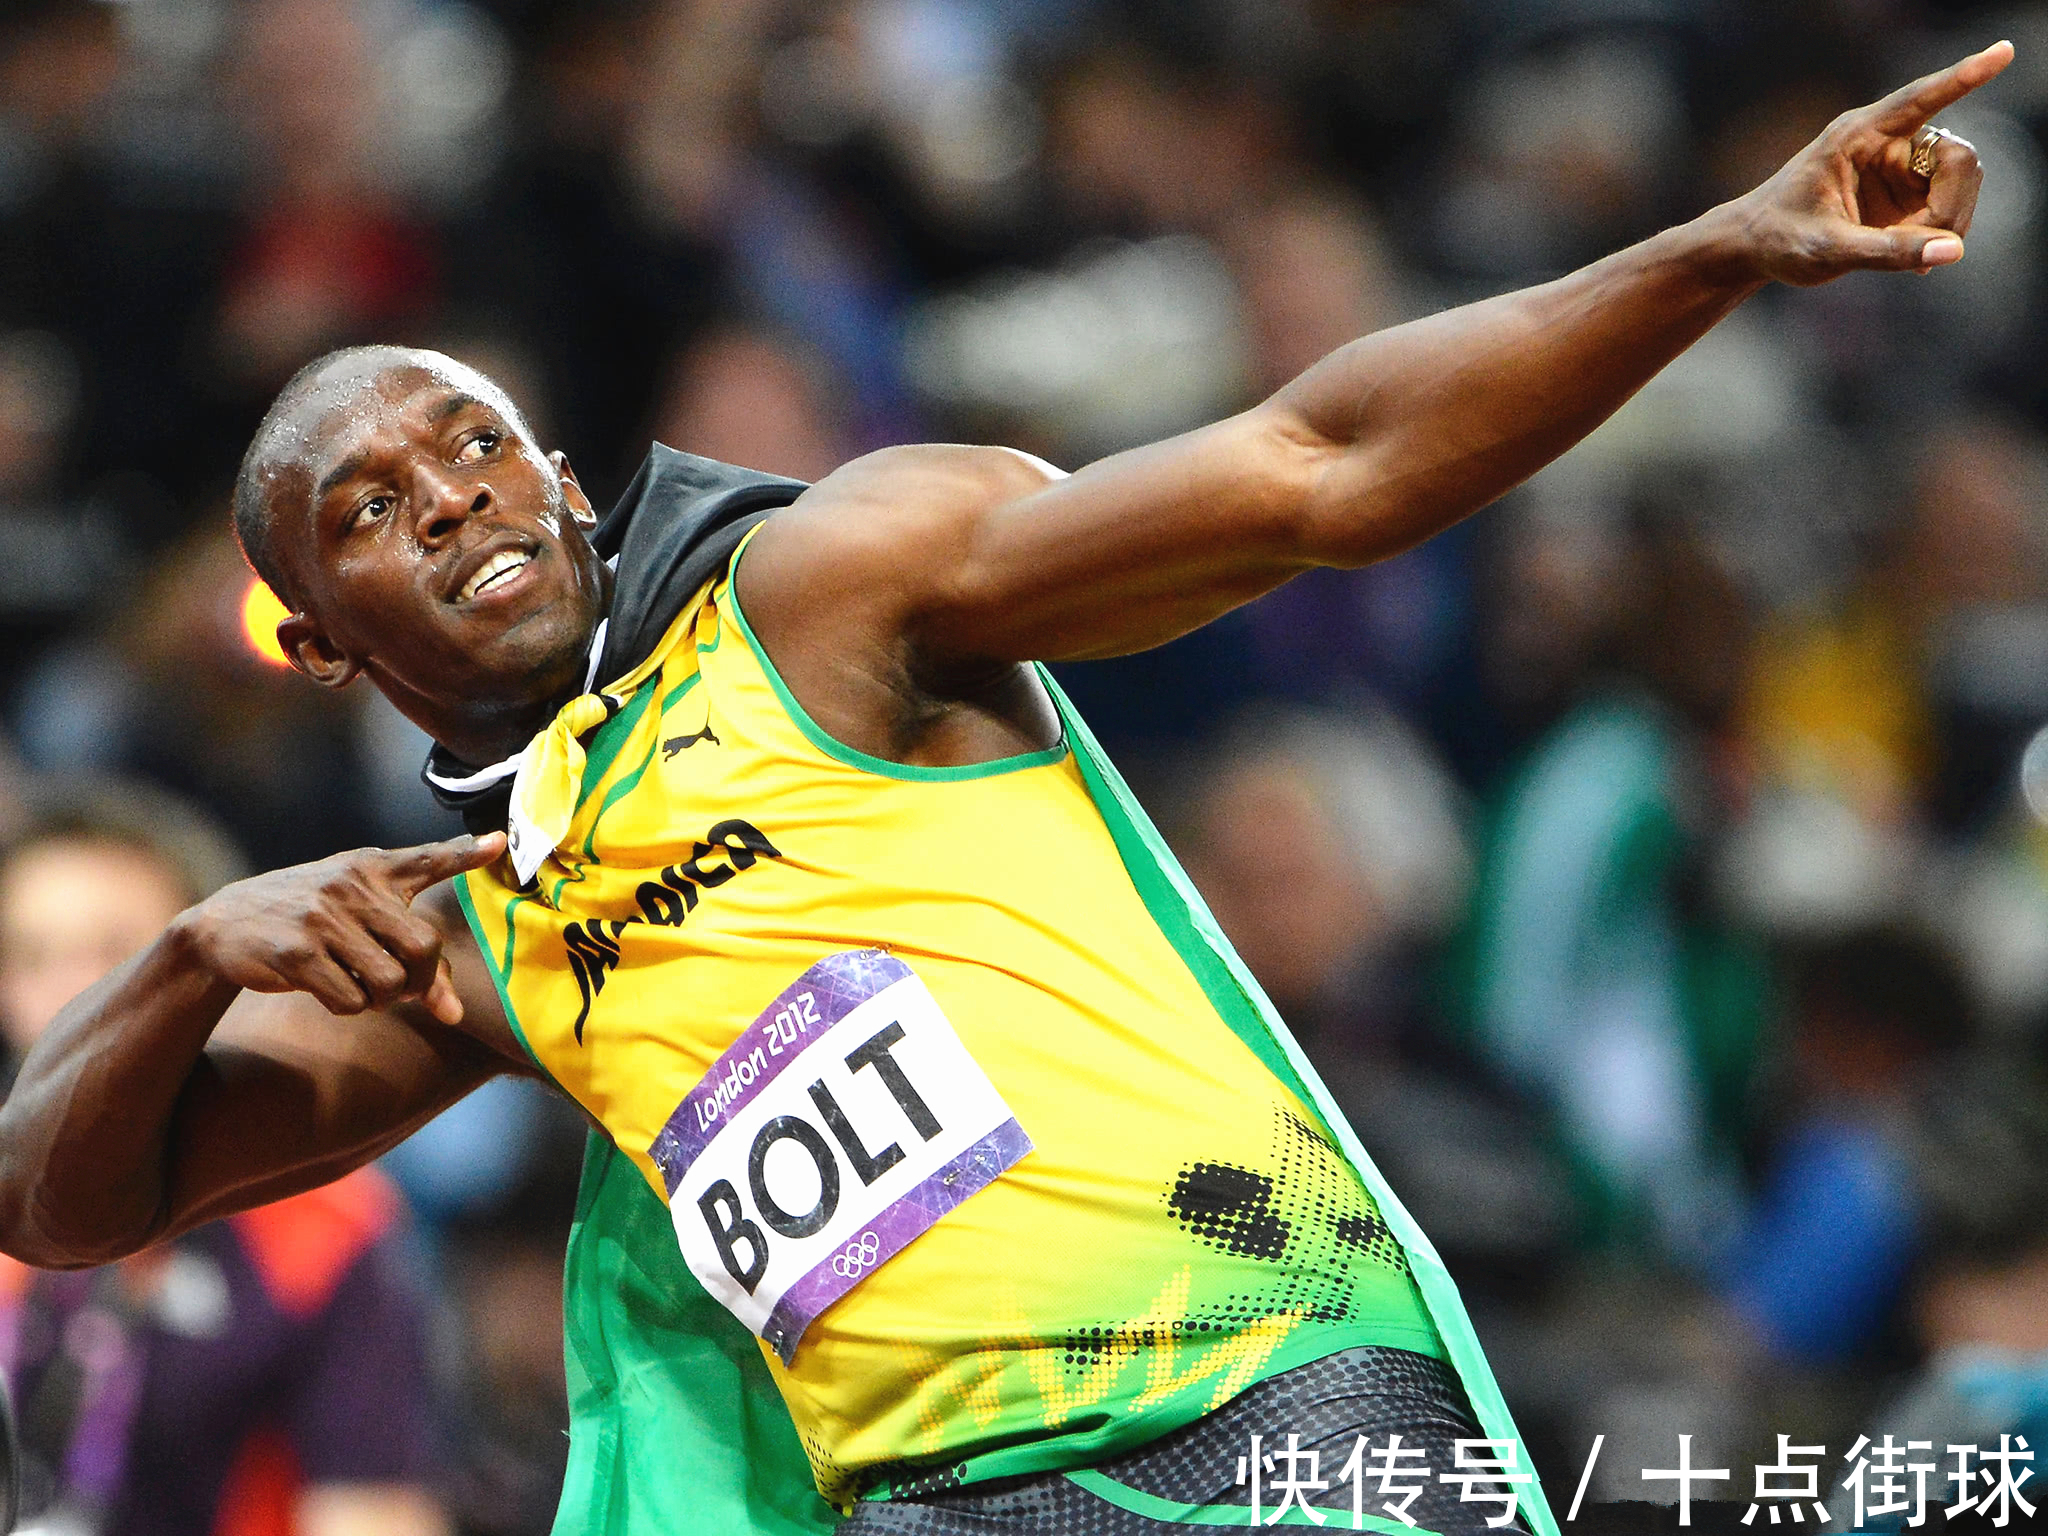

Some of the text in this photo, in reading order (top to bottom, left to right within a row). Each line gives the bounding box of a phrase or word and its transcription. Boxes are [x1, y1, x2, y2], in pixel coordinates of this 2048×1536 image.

[694, 991, 822, 1133] London 2012
[697, 1020, 944, 1297] BOLT
